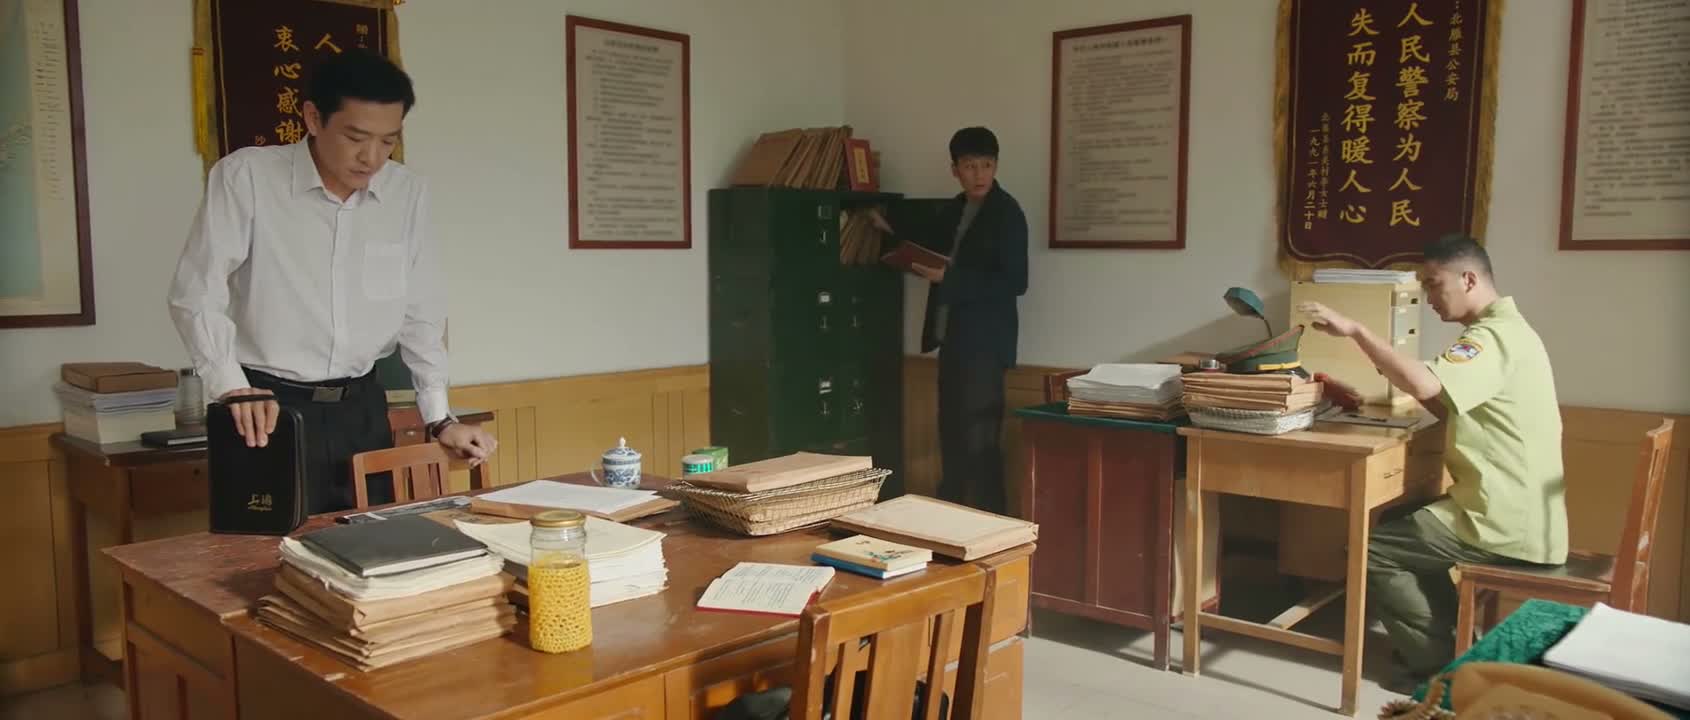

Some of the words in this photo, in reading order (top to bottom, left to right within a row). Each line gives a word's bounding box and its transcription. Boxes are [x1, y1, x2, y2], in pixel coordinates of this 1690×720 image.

[273, 25, 304, 144] 衷心感谢
[1338, 8, 1381, 224] 失而复得暖人心
[1388, 2, 1434, 228] 人民警察为人民
[1303, 128, 1321, 231] 一九九一年六月二十日
